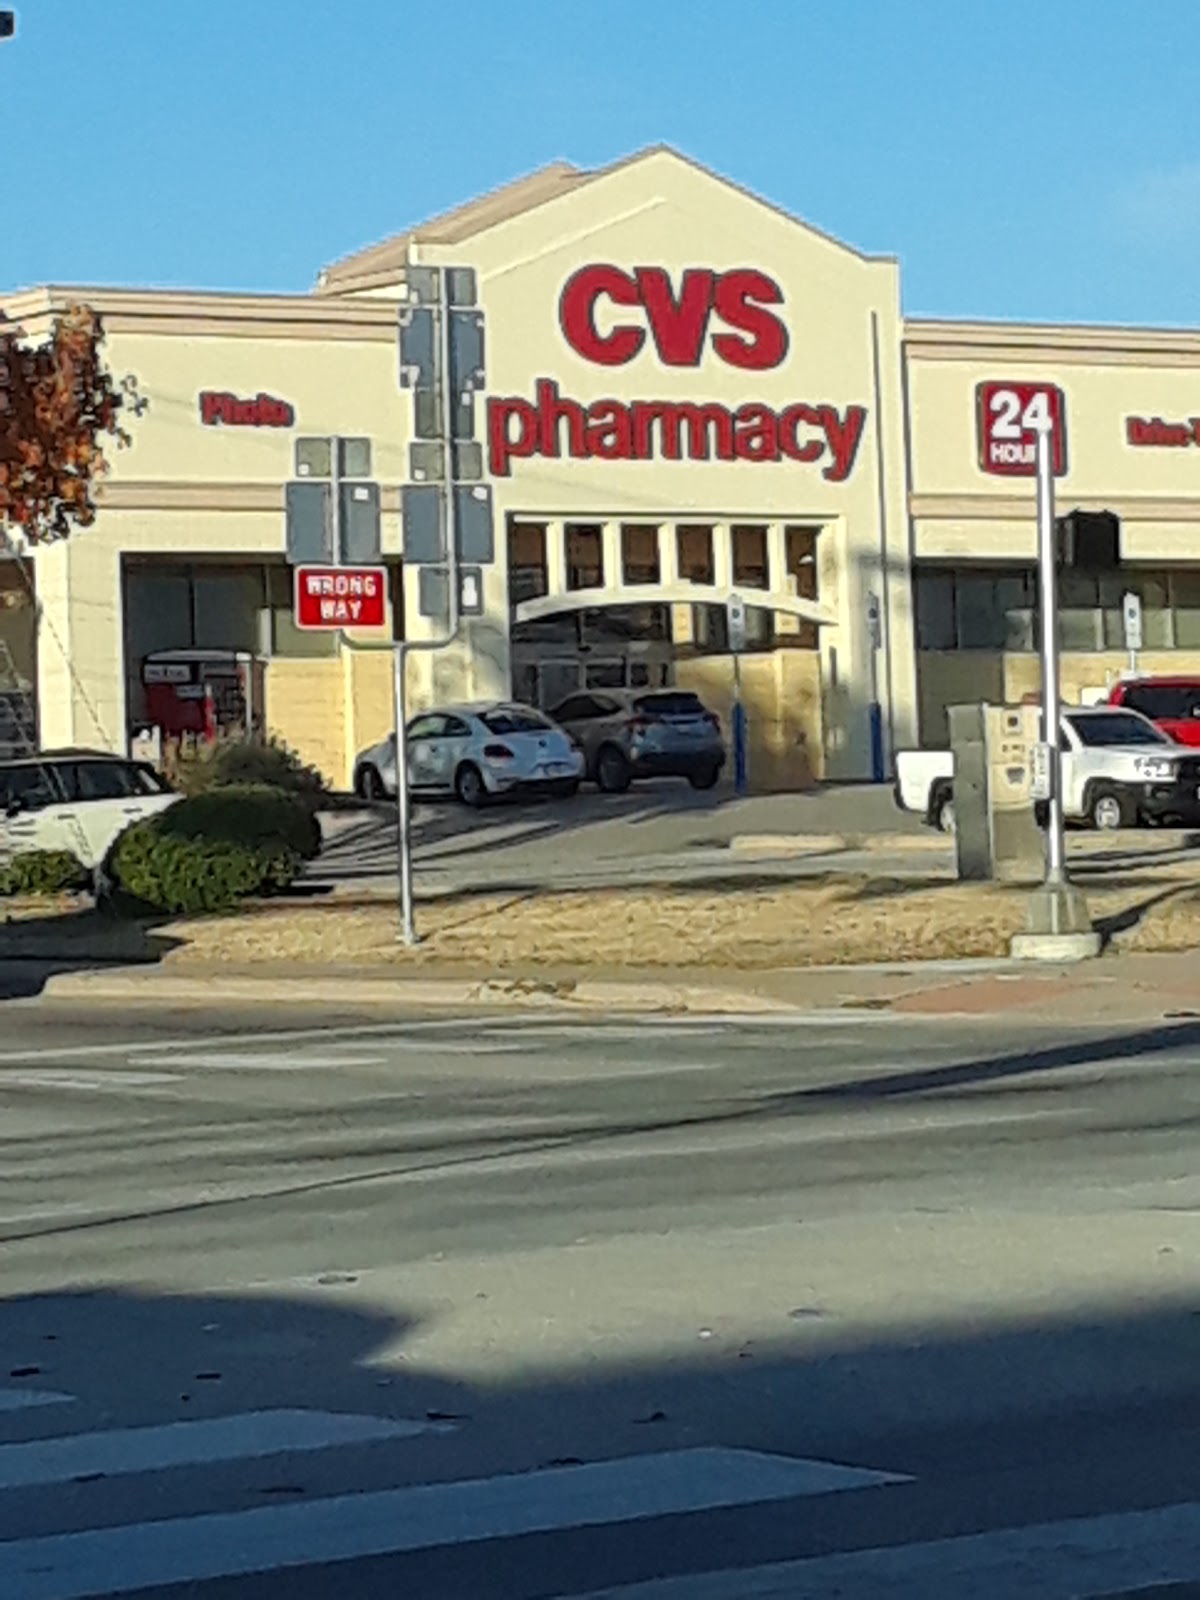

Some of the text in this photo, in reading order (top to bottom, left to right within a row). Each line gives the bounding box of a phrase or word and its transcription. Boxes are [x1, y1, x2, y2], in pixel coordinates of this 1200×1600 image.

[559, 263, 789, 370] CVS
[486, 377, 867, 481] pharmacy
[989, 390, 1053, 438] 24
[306, 575, 377, 597] WRONG
[320, 599, 362, 619] WAY
